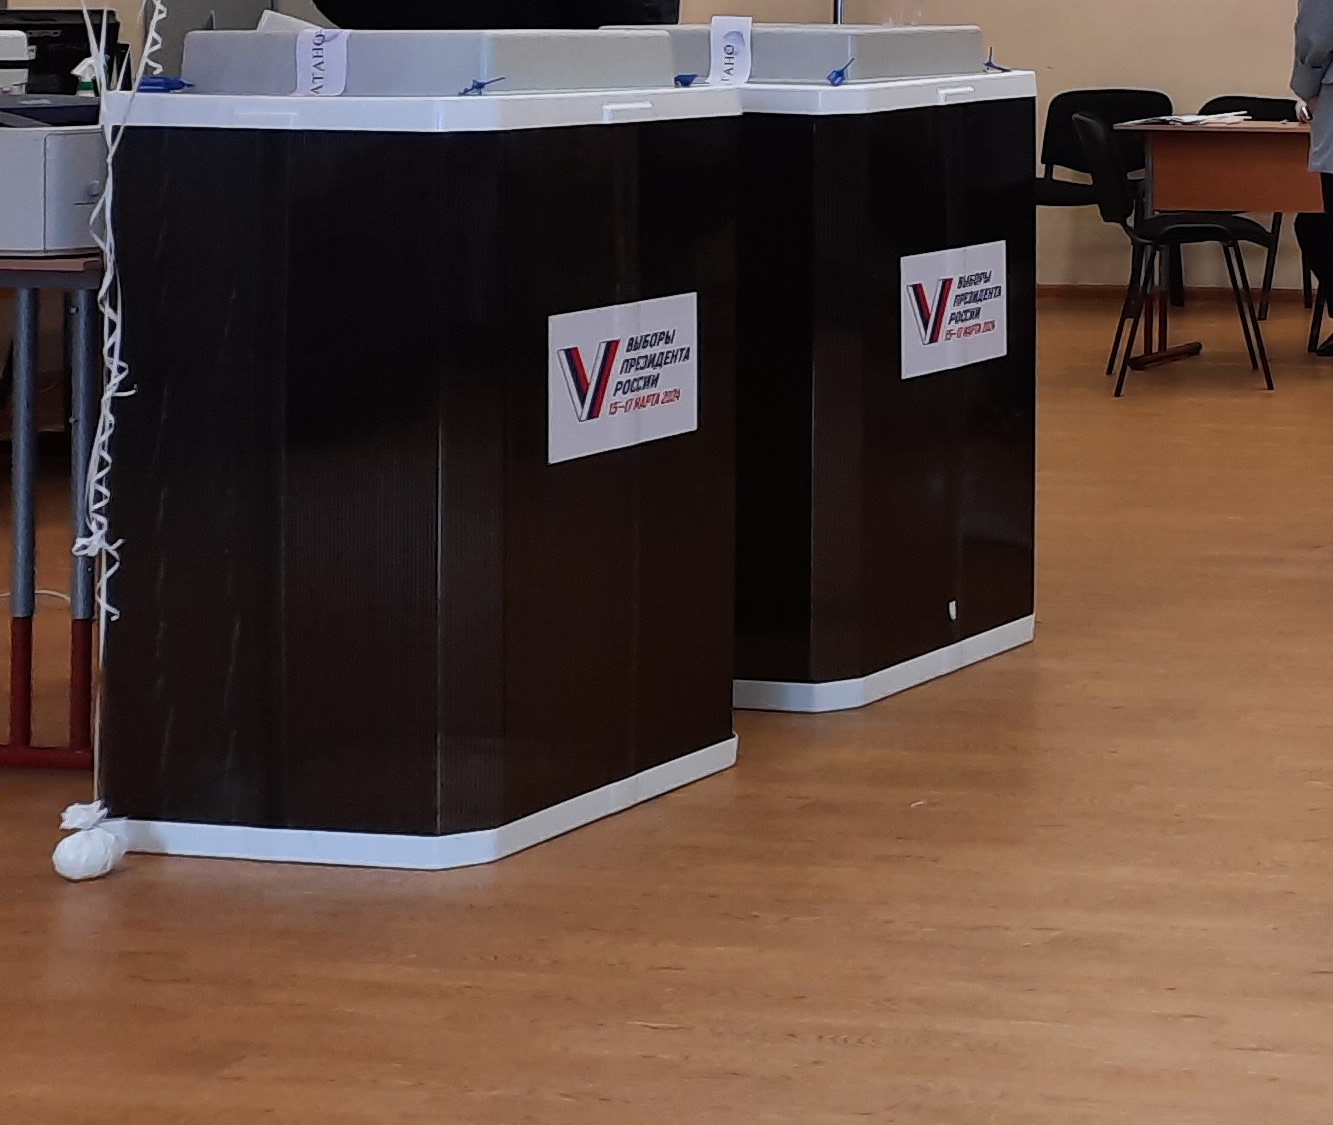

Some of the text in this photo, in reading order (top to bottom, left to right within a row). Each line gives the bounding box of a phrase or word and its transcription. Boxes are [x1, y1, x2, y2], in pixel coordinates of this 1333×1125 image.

[626, 329, 677, 353] ВЫБОРЫ
[619, 346, 692, 376] ПРЕЗИДЕНТА
[613, 373, 661, 397] РОССИИ
